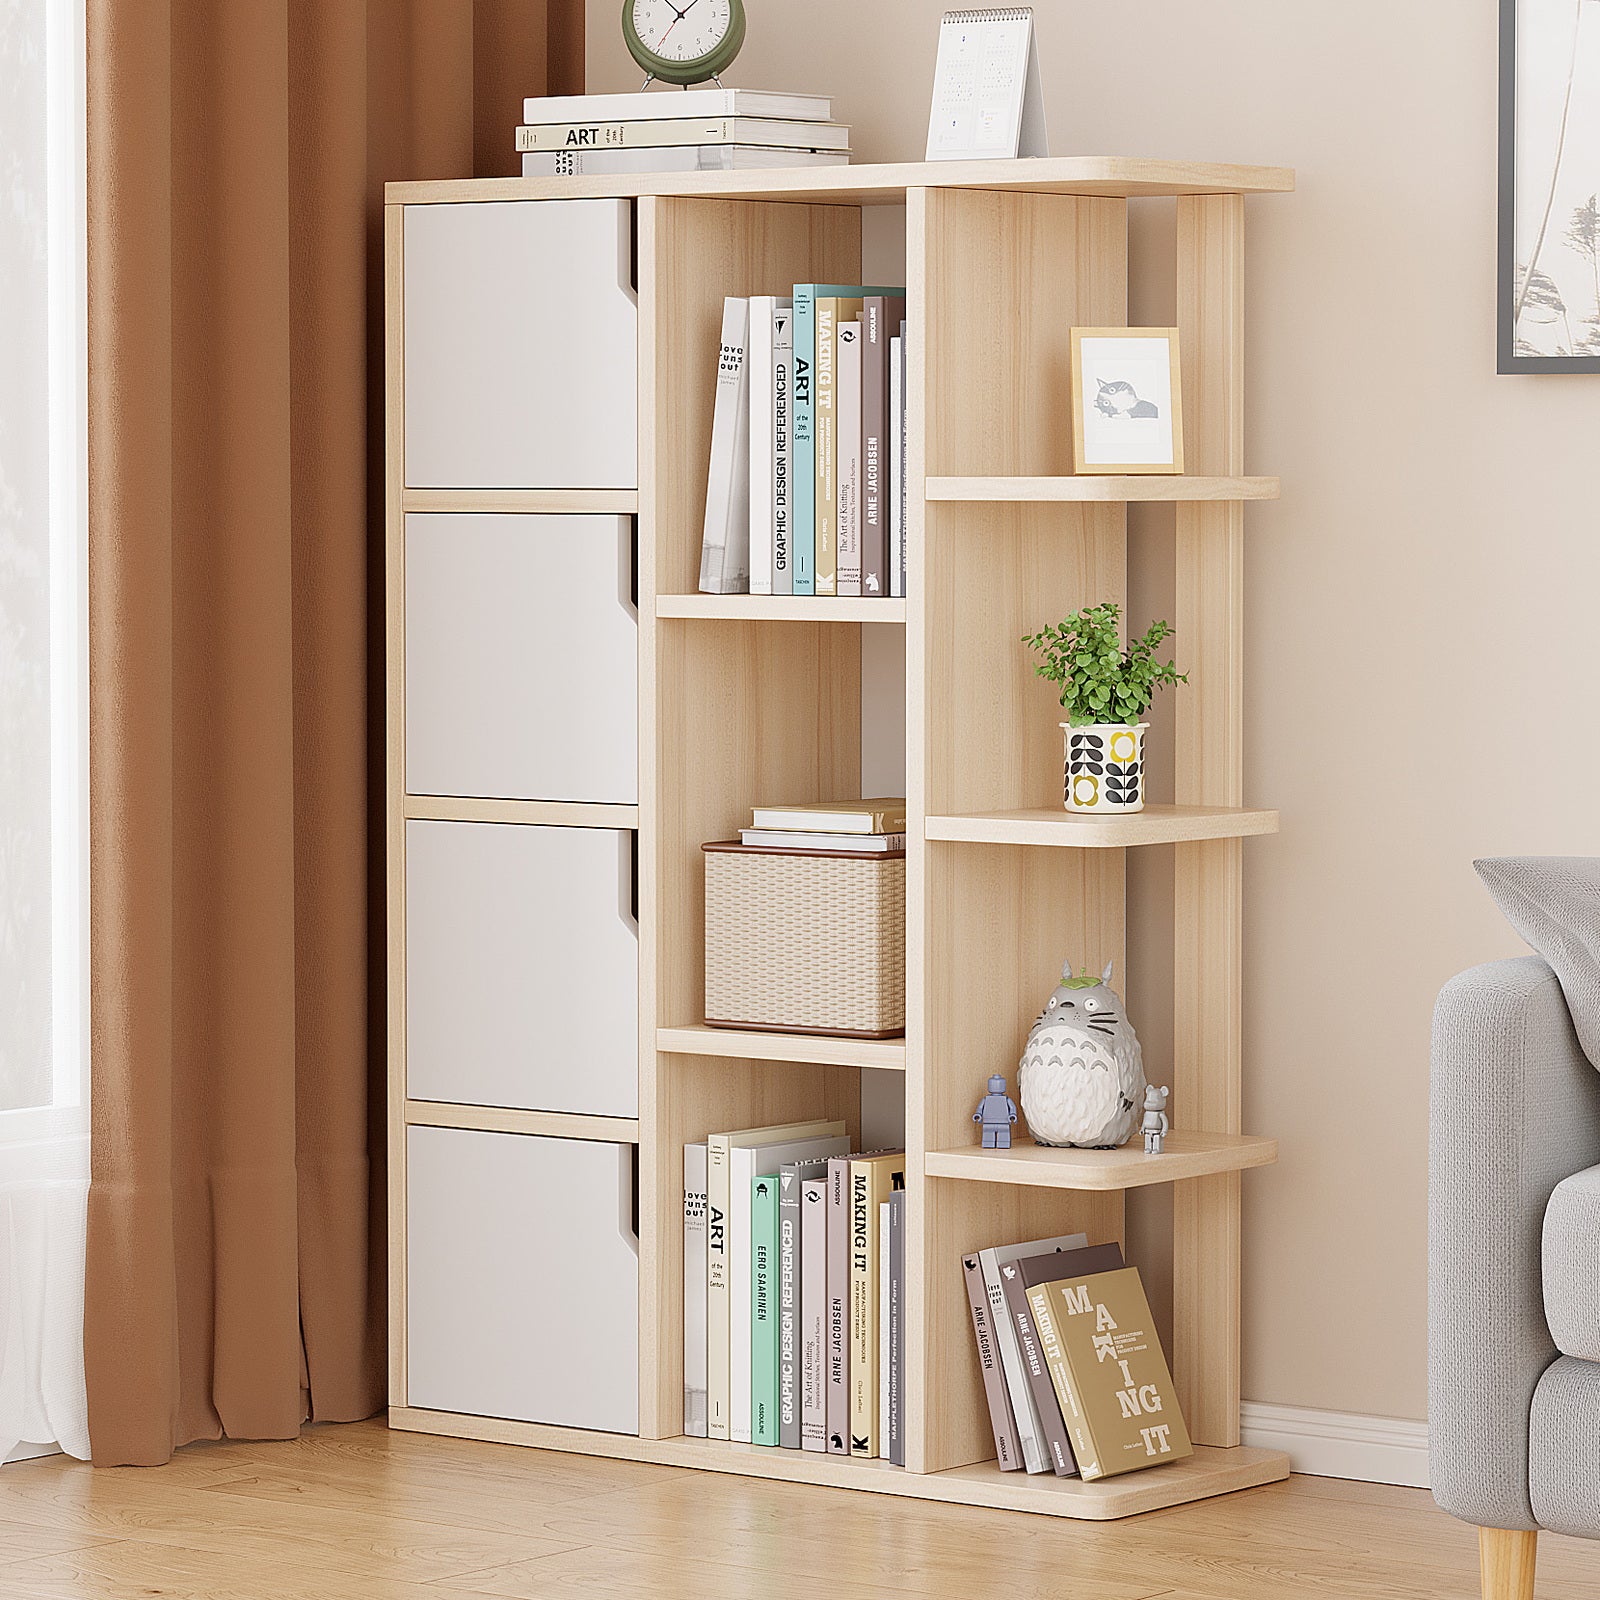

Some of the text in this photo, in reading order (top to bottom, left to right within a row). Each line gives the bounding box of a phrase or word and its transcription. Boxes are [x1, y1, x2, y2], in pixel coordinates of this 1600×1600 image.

[565, 128, 600, 146] ART
[720, 363, 739, 371] out
[795, 357, 809, 405] ART
[818, 310, 832, 409] MAKING IT
[794, 433, 810, 442] Century
[796, 414, 801, 422] of
[776, 364, 786, 571] GRAPHIC DESIGN REFERENCED
[867, 436, 878, 526] ARNE JACOBSEN
[840, 484, 849, 514] Knitting
[840, 515, 847, 523] of
[832, 1170, 841, 1206] ASSOULINE
[710, 1206, 724, 1254] ART
[854, 1175, 867, 1272] MAKING IT
[710, 1280, 725, 1288] Century
[757, 1246, 767, 1321] EERO SAARINEN
[782, 1220, 793, 1307] REFERENCED
[782, 1311, 793, 1361] DESIGN
[832, 1298, 842, 1385] ARNE JACOBSEN
[974, 1306, 993, 1370] ARNE JACOBSEN
[1016, 1313, 1042, 1376] ARNE JACOBSEN
[1032, 1294, 1062, 1359] MAKING IT
[782, 1364, 793, 1425] GRAPHIC
[804, 1341, 814, 1408] The Art of Knitting
[1140, 1424, 1172, 1456] IT
